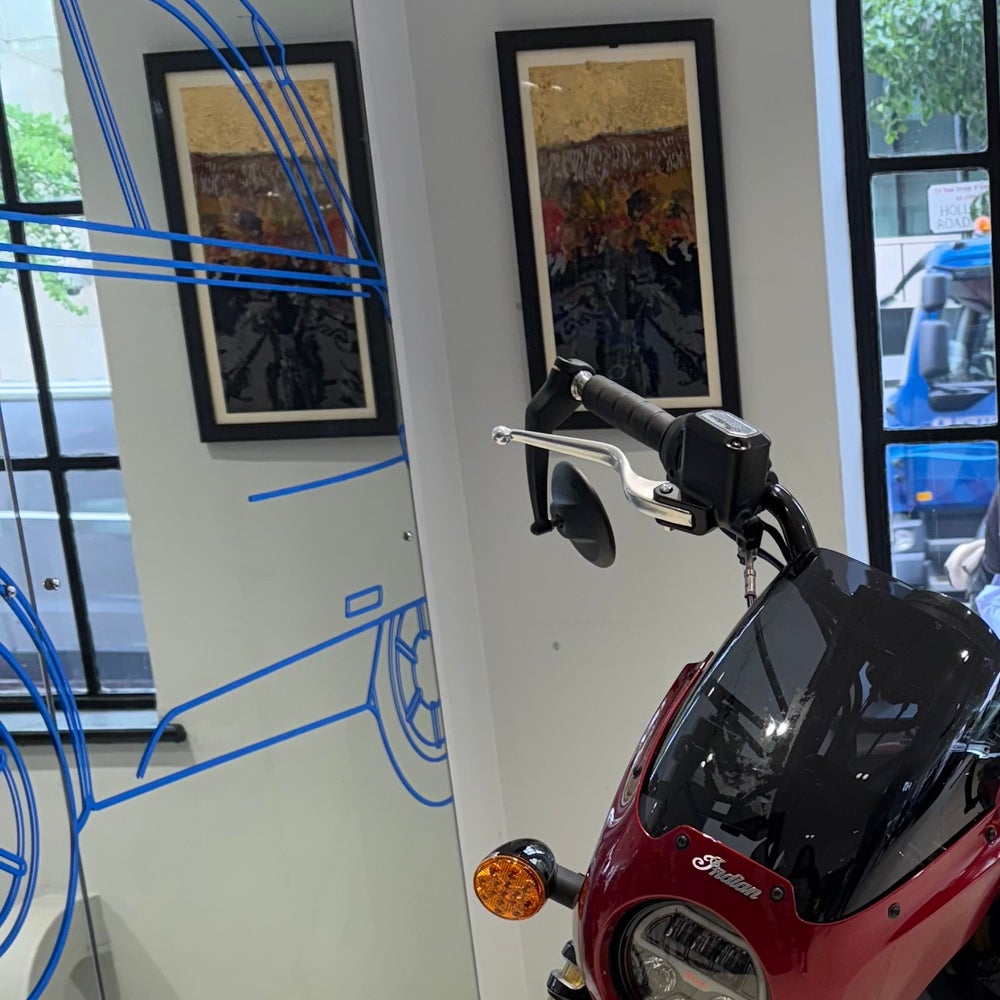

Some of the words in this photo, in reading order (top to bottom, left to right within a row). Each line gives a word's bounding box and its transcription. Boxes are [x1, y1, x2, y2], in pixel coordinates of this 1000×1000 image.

[940, 203, 970, 217] HOLL
[936, 216, 971, 230] ROAD
[692, 854, 763, 900] Indian
